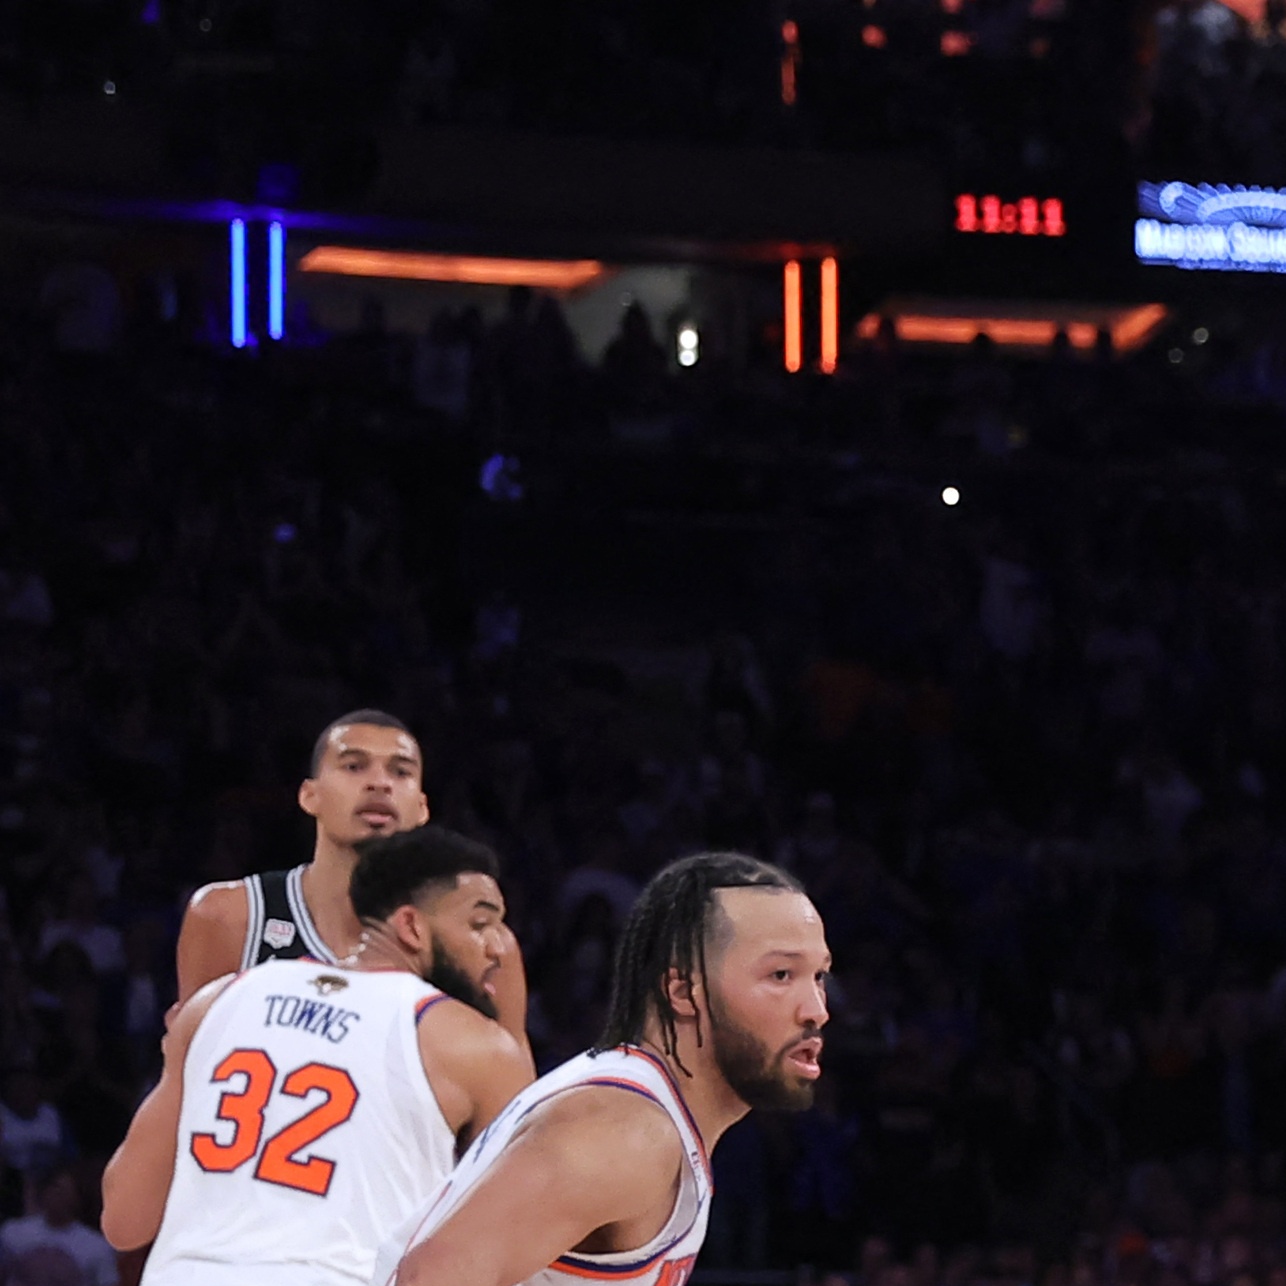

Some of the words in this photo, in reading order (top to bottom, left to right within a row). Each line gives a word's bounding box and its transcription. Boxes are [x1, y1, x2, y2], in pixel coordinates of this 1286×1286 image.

[956, 194, 1065, 236] 11:11
[265, 994, 360, 1043] TOWNS
[190, 1048, 358, 1197] 32
